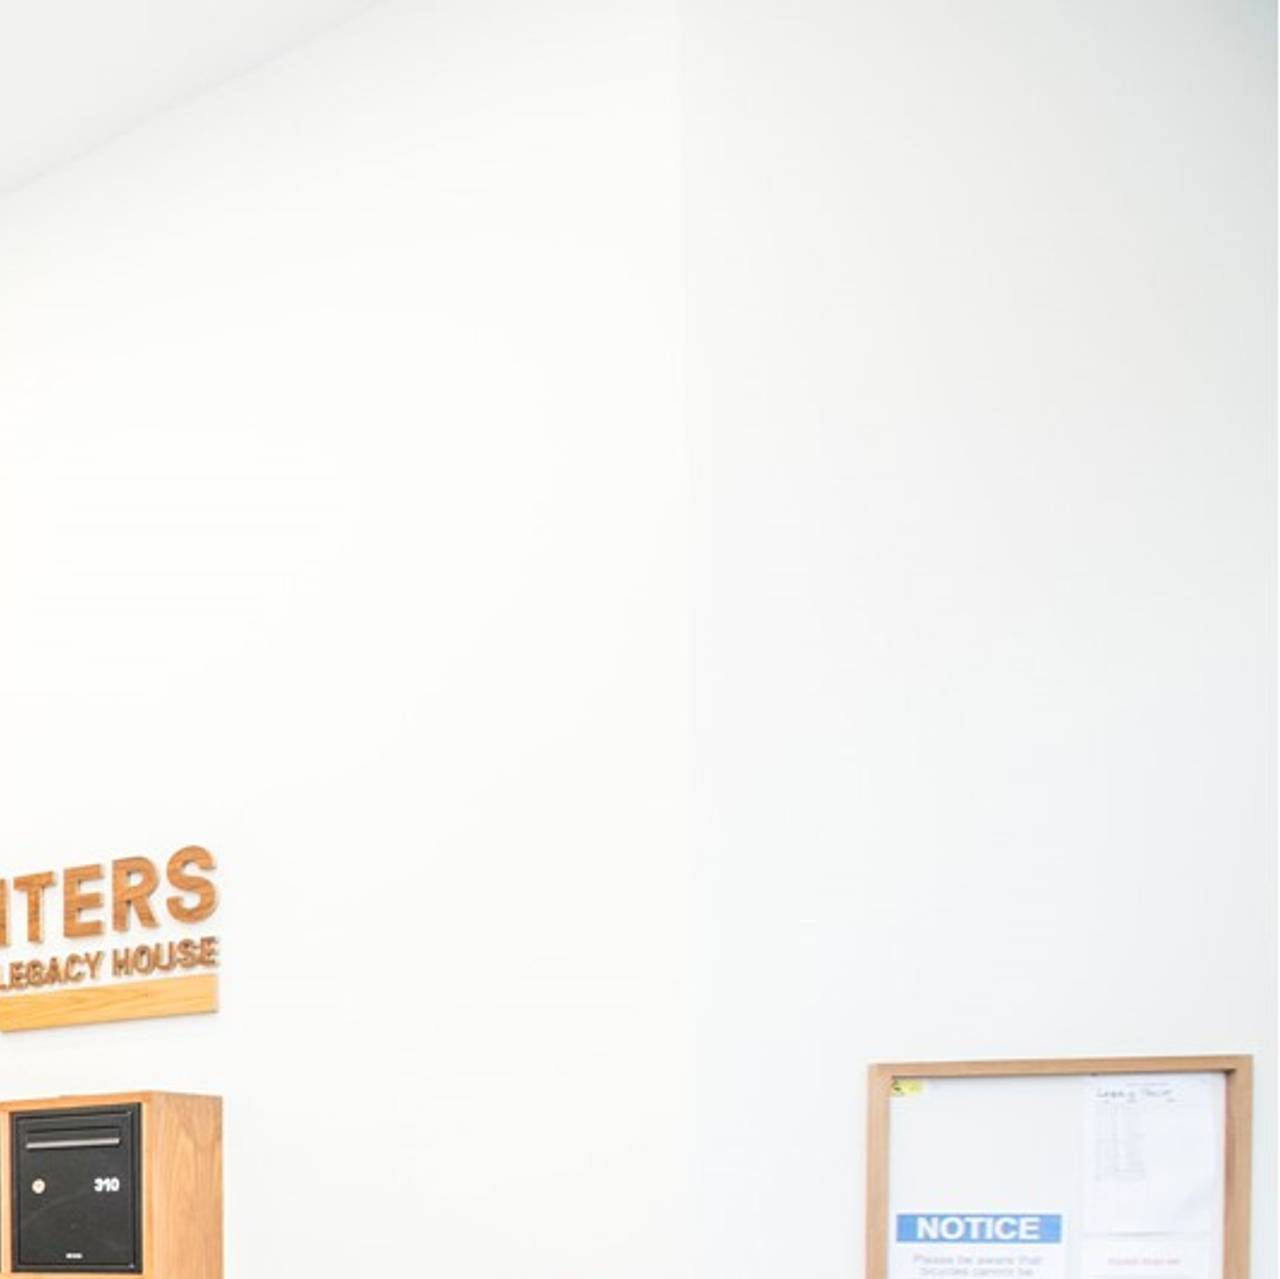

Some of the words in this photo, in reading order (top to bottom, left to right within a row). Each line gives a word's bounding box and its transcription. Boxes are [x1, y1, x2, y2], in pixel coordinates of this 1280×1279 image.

[111, 936, 219, 977] HOUSE
[93, 1176, 122, 1194] 310
[916, 1216, 1041, 1240] NOTICE
